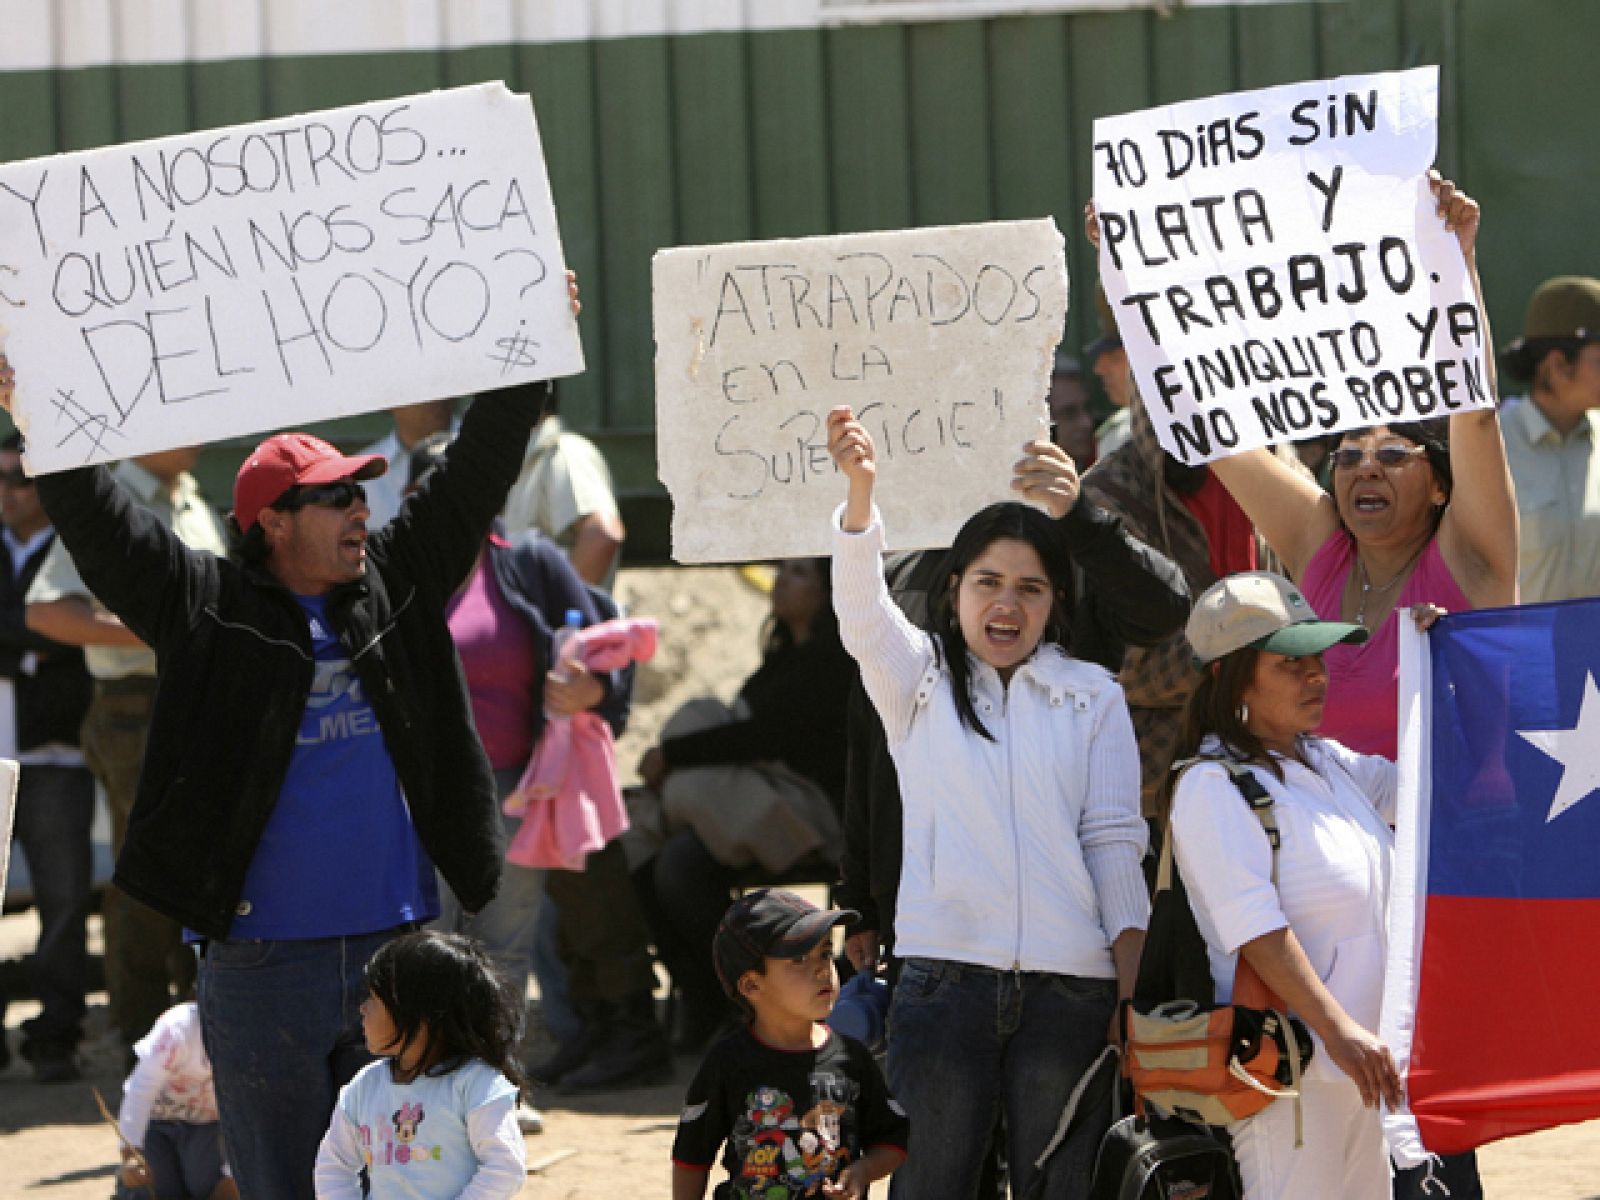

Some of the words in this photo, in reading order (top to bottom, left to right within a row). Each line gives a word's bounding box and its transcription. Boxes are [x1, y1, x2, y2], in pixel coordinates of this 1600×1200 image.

[0, 171, 47, 258] Y
[79, 165, 118, 238] A
[1094, 137, 1148, 188] 70
[249, 205, 375, 272] NOS
[381, 178, 536, 249] SACA
[1100, 188, 1273, 270] PLATA
[1307, 165, 1343, 232] Y
[1121, 236, 1441, 345] TRABAJO.
[80, 294, 255, 427] DEL
[831, 343, 893, 380] LA
[1153, 321, 1383, 414] FINIQUITO
[1407, 302, 1481, 359] YA
[1170, 409, 1239, 461] NO
[1251, 382, 1340, 440] NOS
[1345, 358, 1486, 420] ROBEN
